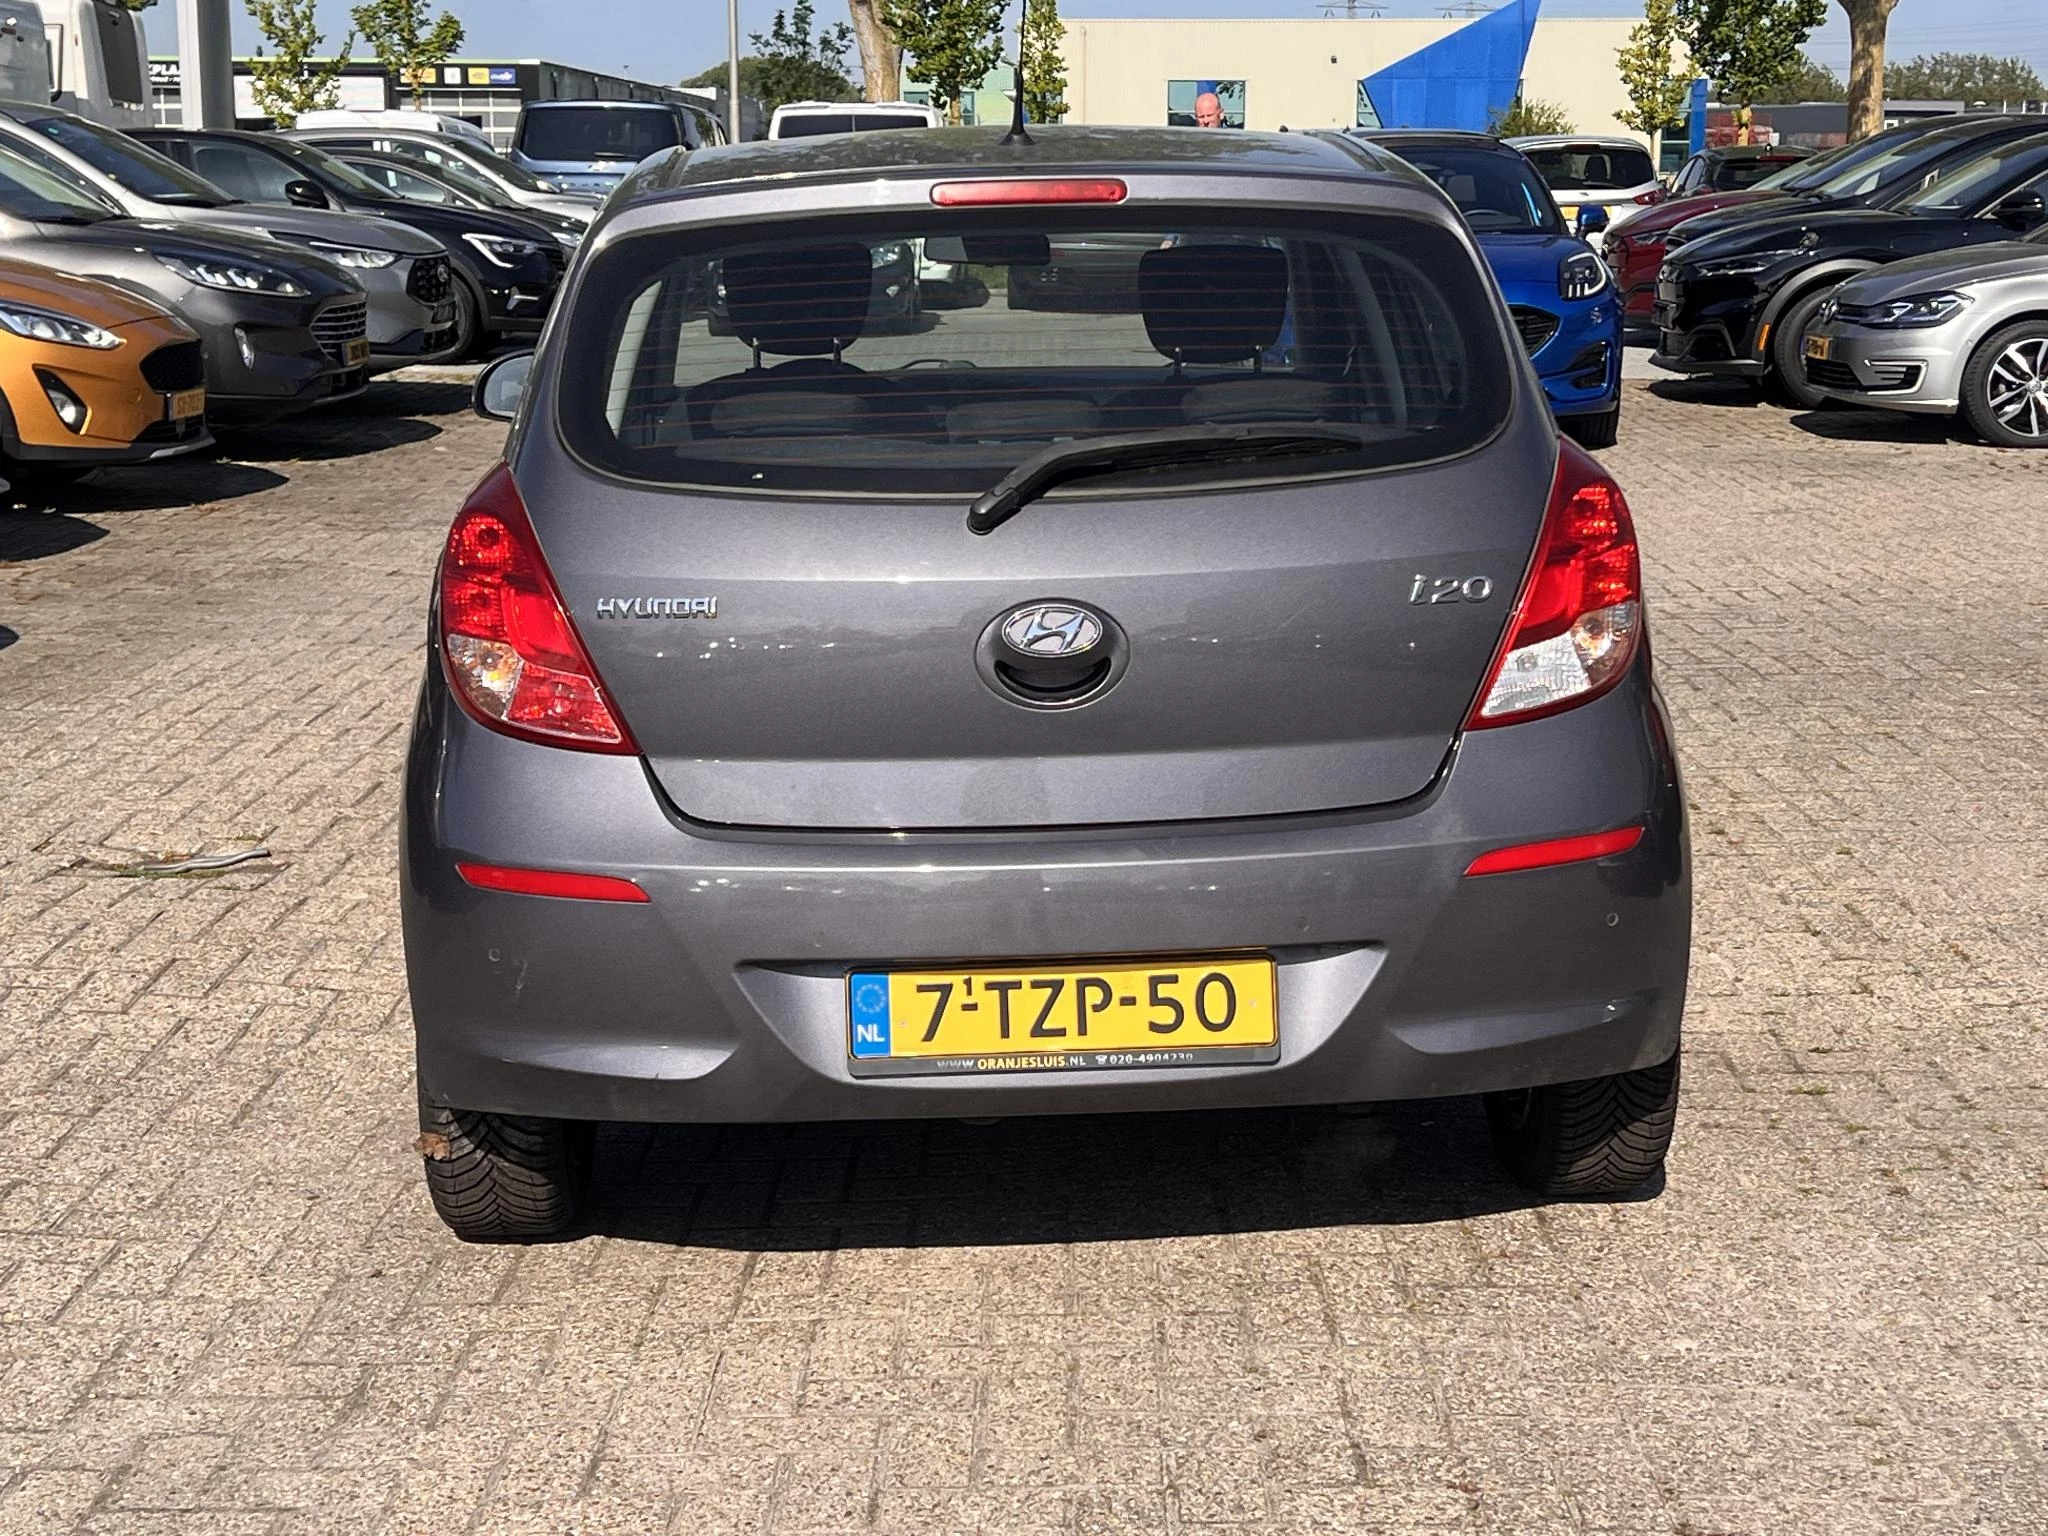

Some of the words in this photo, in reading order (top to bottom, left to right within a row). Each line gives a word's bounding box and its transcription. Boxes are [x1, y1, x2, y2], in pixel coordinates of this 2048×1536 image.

[1408, 573, 1493, 606] i20
[596, 596, 718, 619] HYUNDAI
[857, 1023, 886, 1043] NL
